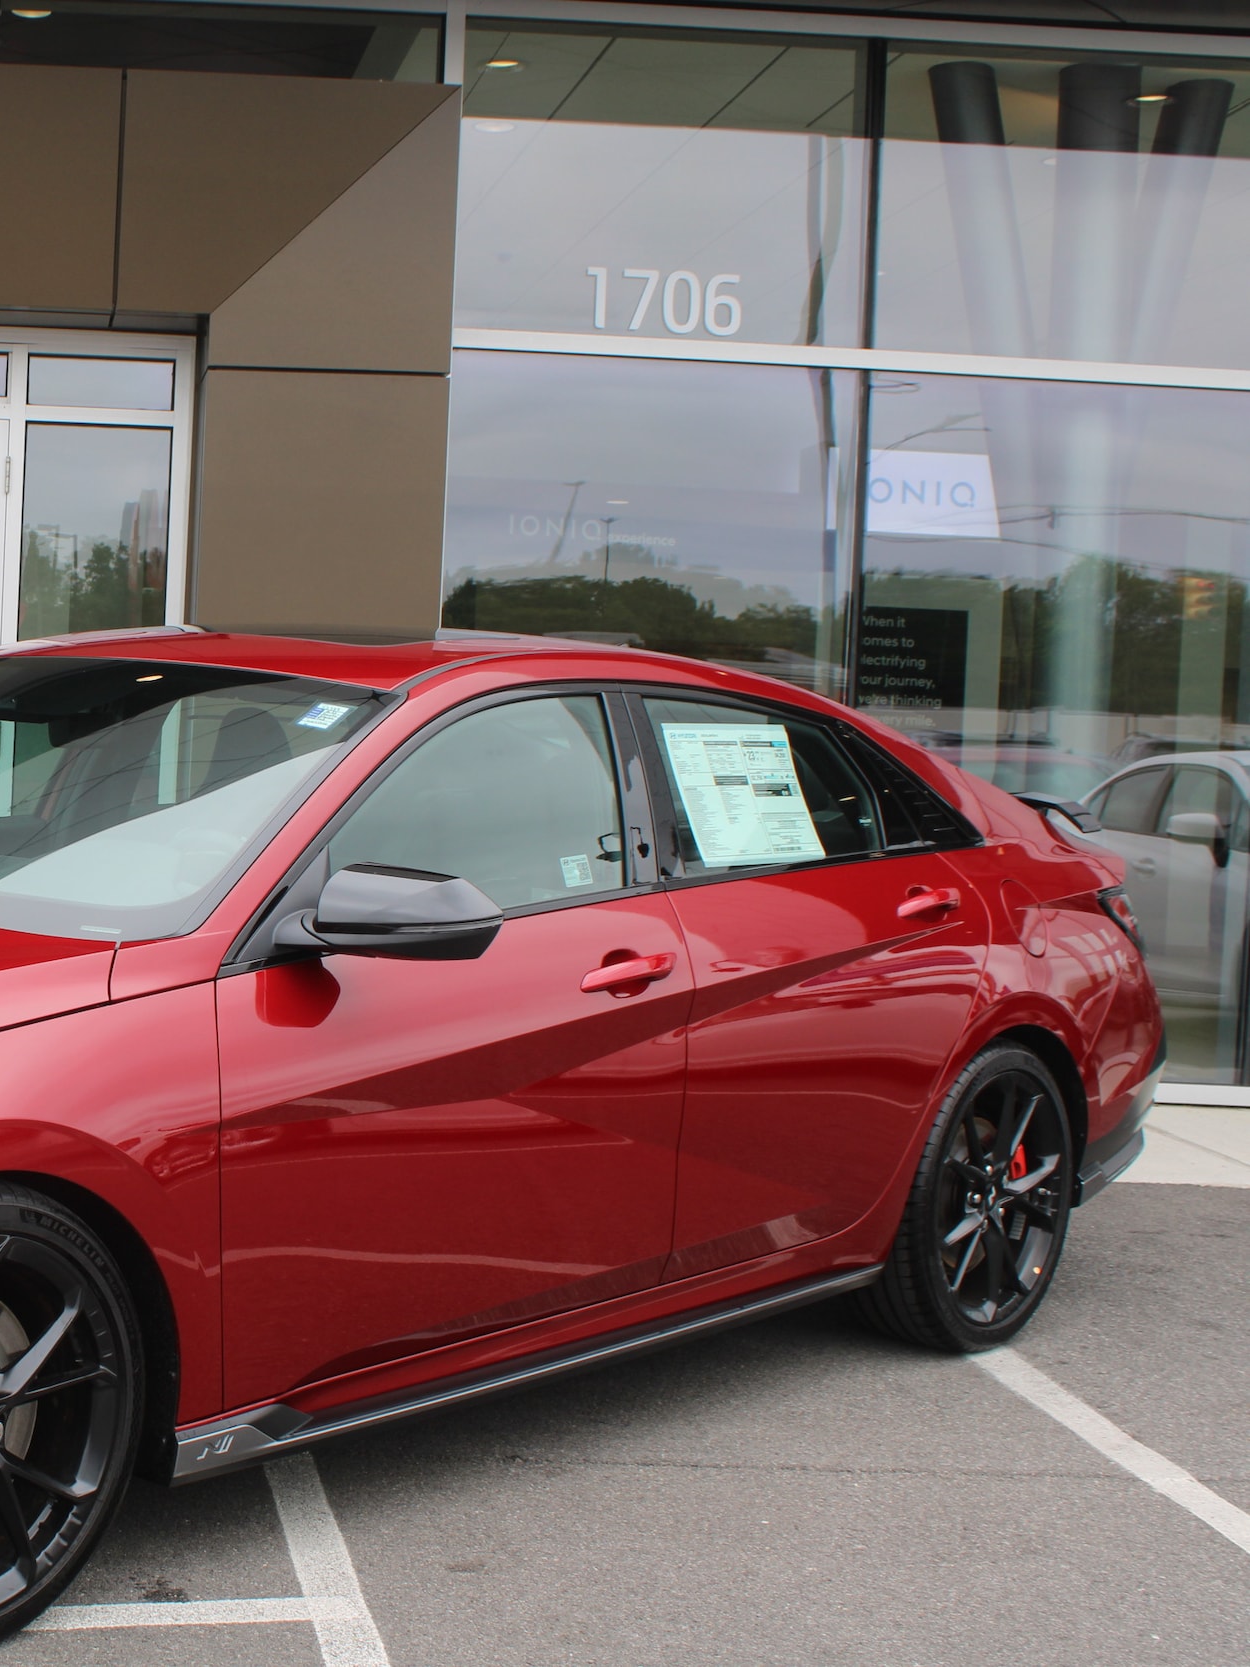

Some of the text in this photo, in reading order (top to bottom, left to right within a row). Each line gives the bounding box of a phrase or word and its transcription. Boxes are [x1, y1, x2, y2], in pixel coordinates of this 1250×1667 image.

[586, 266, 742, 337] 1706
[869, 476, 976, 508] ONIQ
[897, 616, 906, 628] it
[862, 638, 915, 648] omes to
[860, 654, 927, 670] lectrifying
[861, 675, 935, 689] our journey,
[890, 695, 942, 710] thinking
[39, 1214, 105, 1267] MICHELIN
